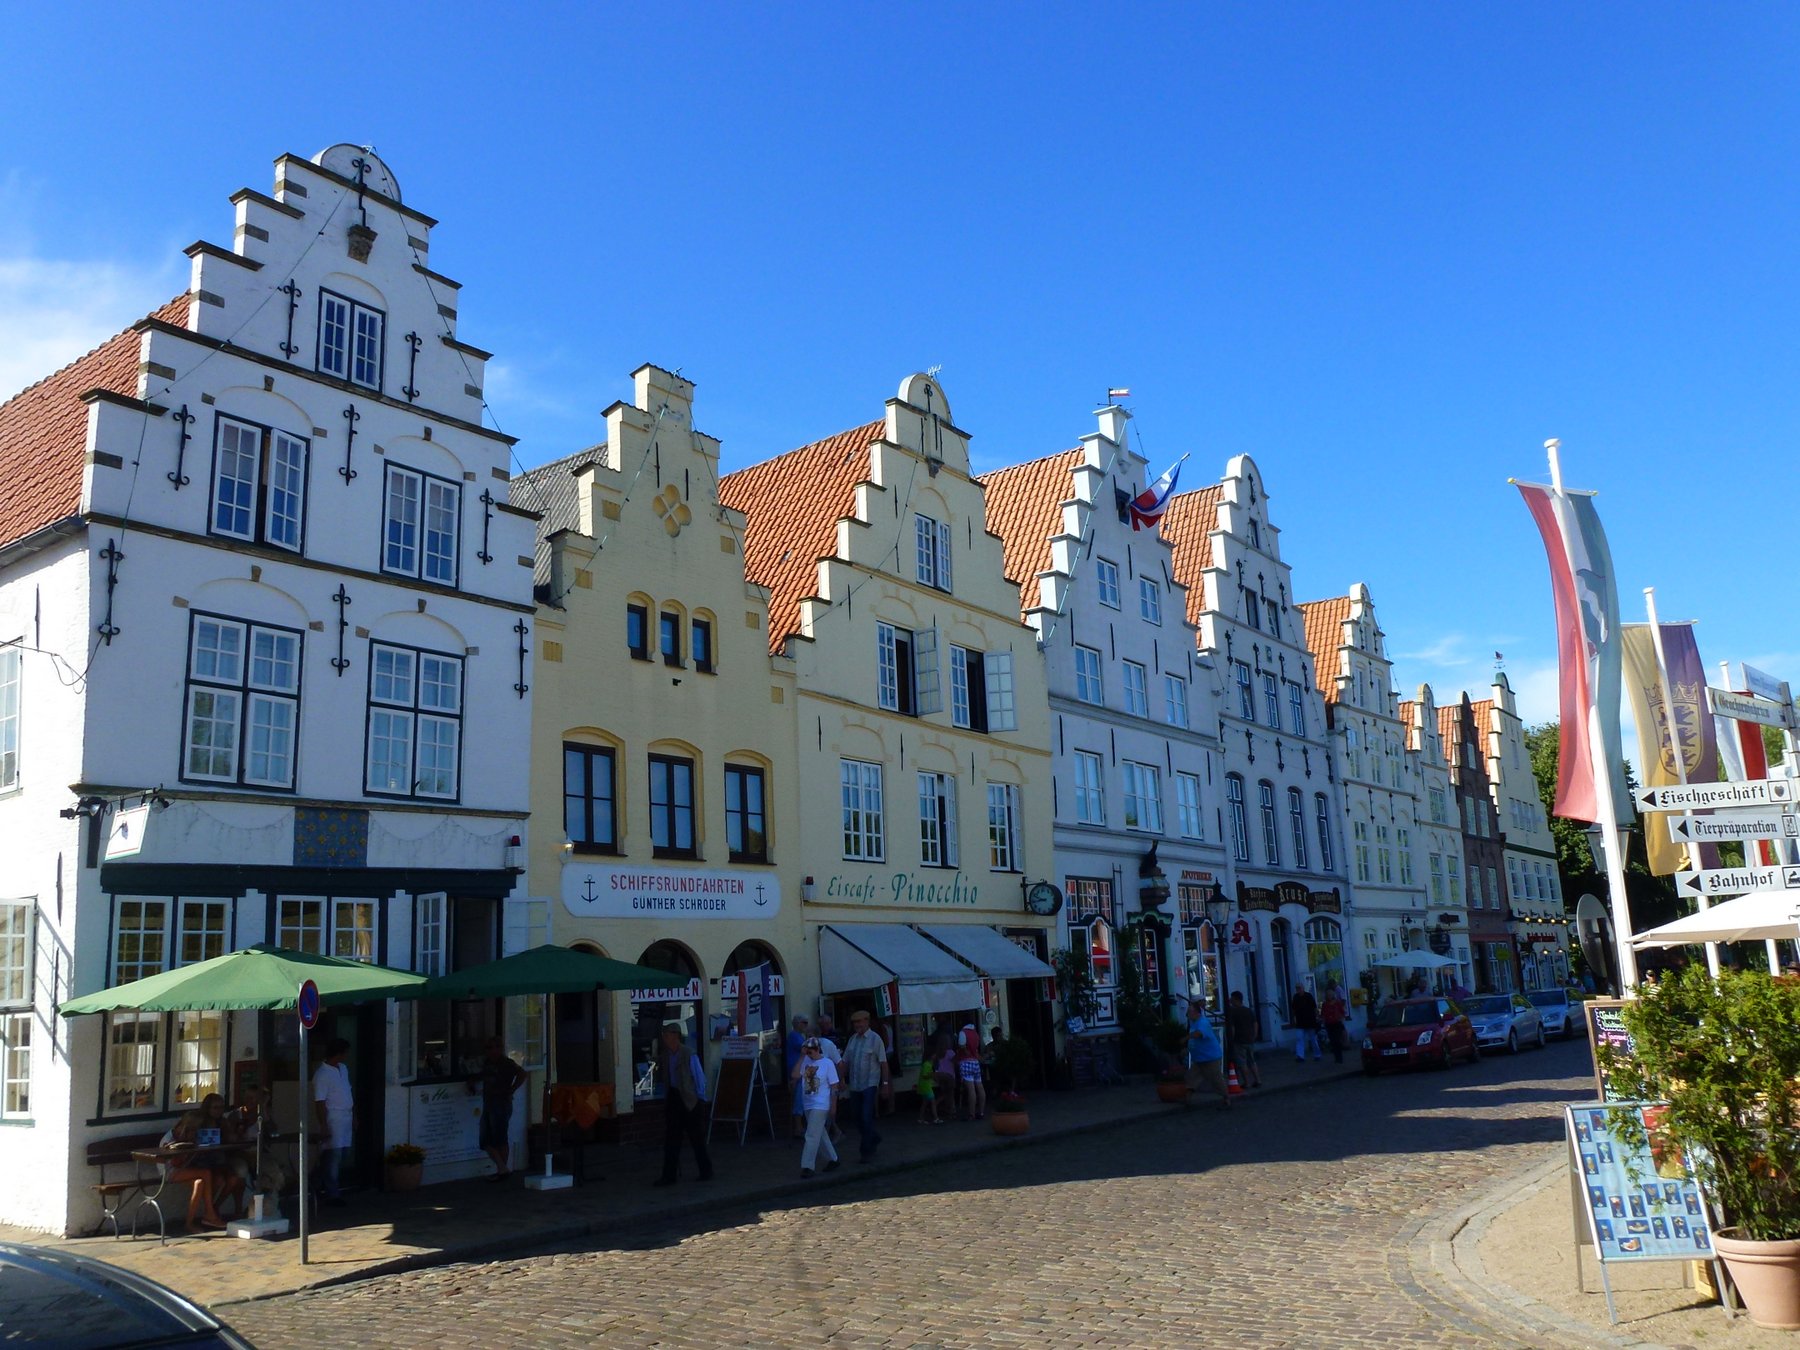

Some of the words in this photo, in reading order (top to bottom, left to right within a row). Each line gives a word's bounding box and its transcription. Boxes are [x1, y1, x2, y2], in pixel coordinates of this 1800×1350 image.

[1660, 784, 1765, 808] Fischgeschäft
[1694, 818, 1778, 837] Tierpräparation
[611, 874, 744, 894] SCHIFFSRUNDFAHRTEN
[891, 869, 978, 904] Pinocchio
[1708, 871, 1774, 892] Bahnhof
